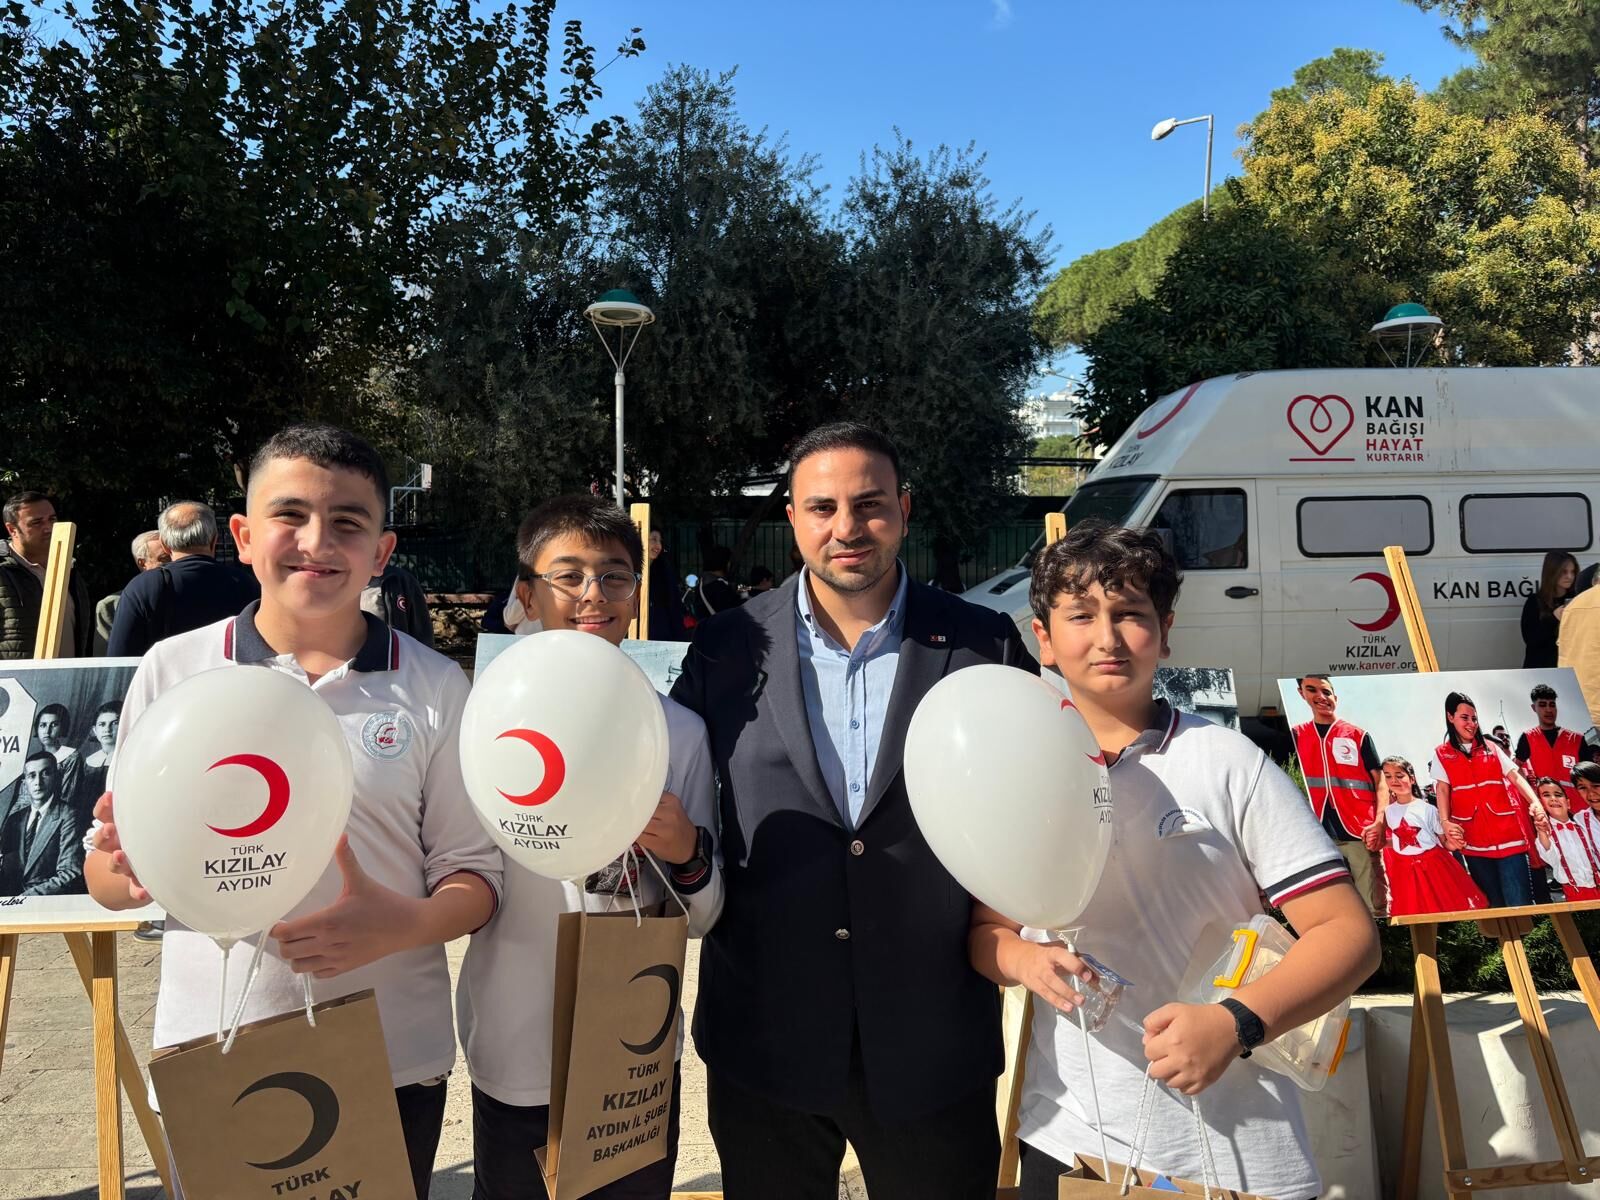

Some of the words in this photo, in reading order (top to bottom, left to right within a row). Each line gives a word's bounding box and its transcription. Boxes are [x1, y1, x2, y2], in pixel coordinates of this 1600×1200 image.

[1365, 396, 1424, 418] KAN
[1366, 419, 1424, 438] BAĞIŞI
[1366, 439, 1424, 451] HAYAT
[1366, 453, 1424, 462] KURTARIR
[1433, 581, 1480, 599] KAN
[1487, 576, 1540, 598] BAĞI
[1361, 634, 1387, 644] TÜRK
[1345, 645, 1401, 658] KIZILAY
[0, 735, 20, 754] YA
[515, 812, 544, 823] TÜRK
[499, 818, 568, 837] KIZILAY
[231, 844, 264, 855] TÜRK
[514, 838, 560, 850] AYDIN
[205, 851, 287, 875] KIZILAY
[216, 874, 271, 892] AYDIN
[628, 1060, 660, 1080] TÜRK
[603, 1079, 667, 1111] KIZILAY
[586, 1120, 630, 1141] AYDIN
[632, 1114, 641, 1130] İL
[645, 1101, 668, 1125] ŞUBE
[593, 1125, 660, 1162] BAŞKANLIĞI
[271, 1166, 331, 1195] TÜRK
